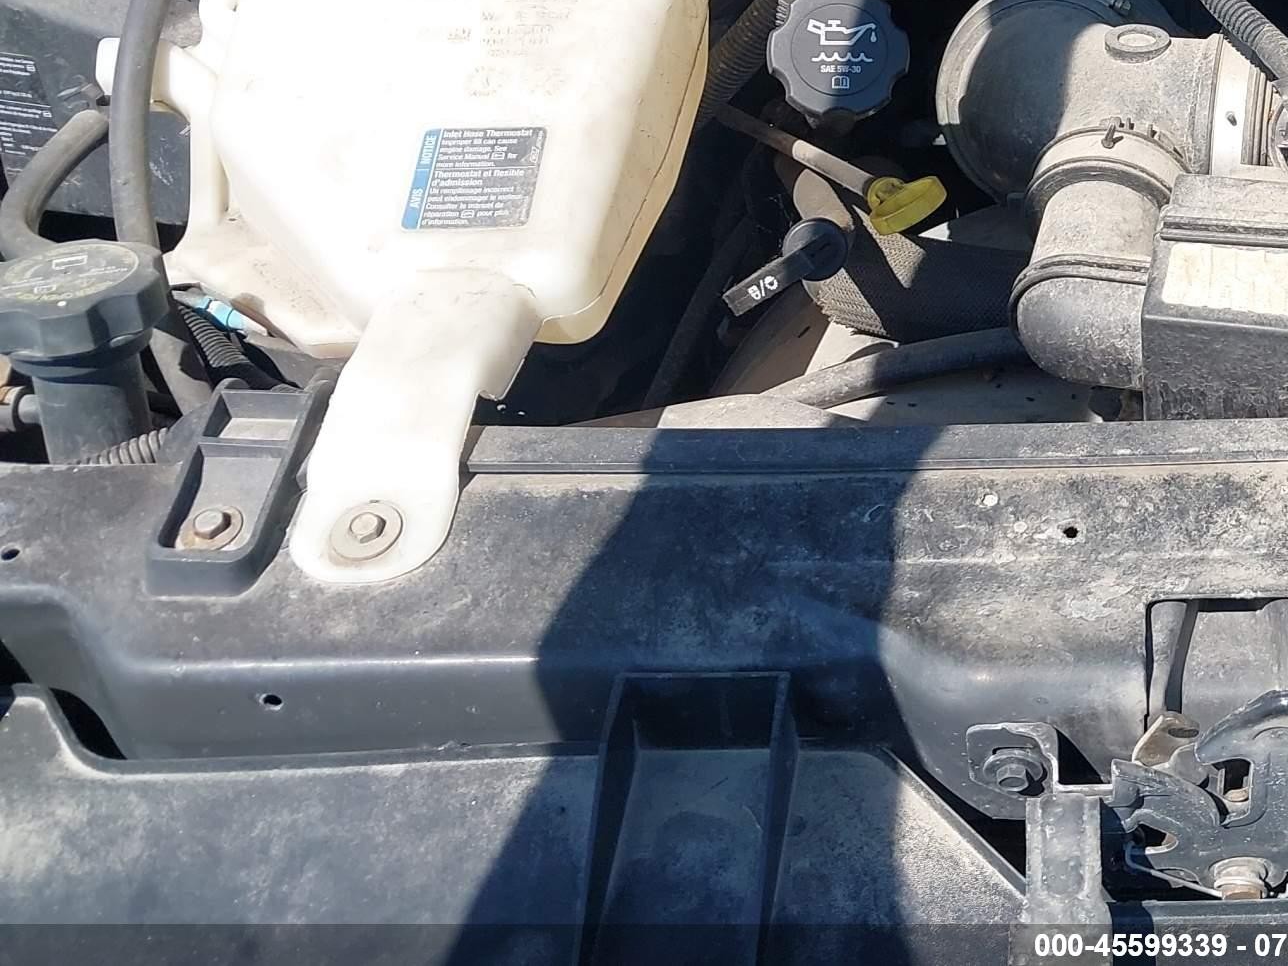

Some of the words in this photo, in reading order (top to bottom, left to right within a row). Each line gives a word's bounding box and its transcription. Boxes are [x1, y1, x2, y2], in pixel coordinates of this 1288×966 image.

[820, 64, 836, 73] SAE
[837, 65, 862, 73] 5W-30
[486, 129, 533, 137] Thermostat
[434, 170, 482, 179] Thermostat
[409, 188, 424, 209] AVIS
